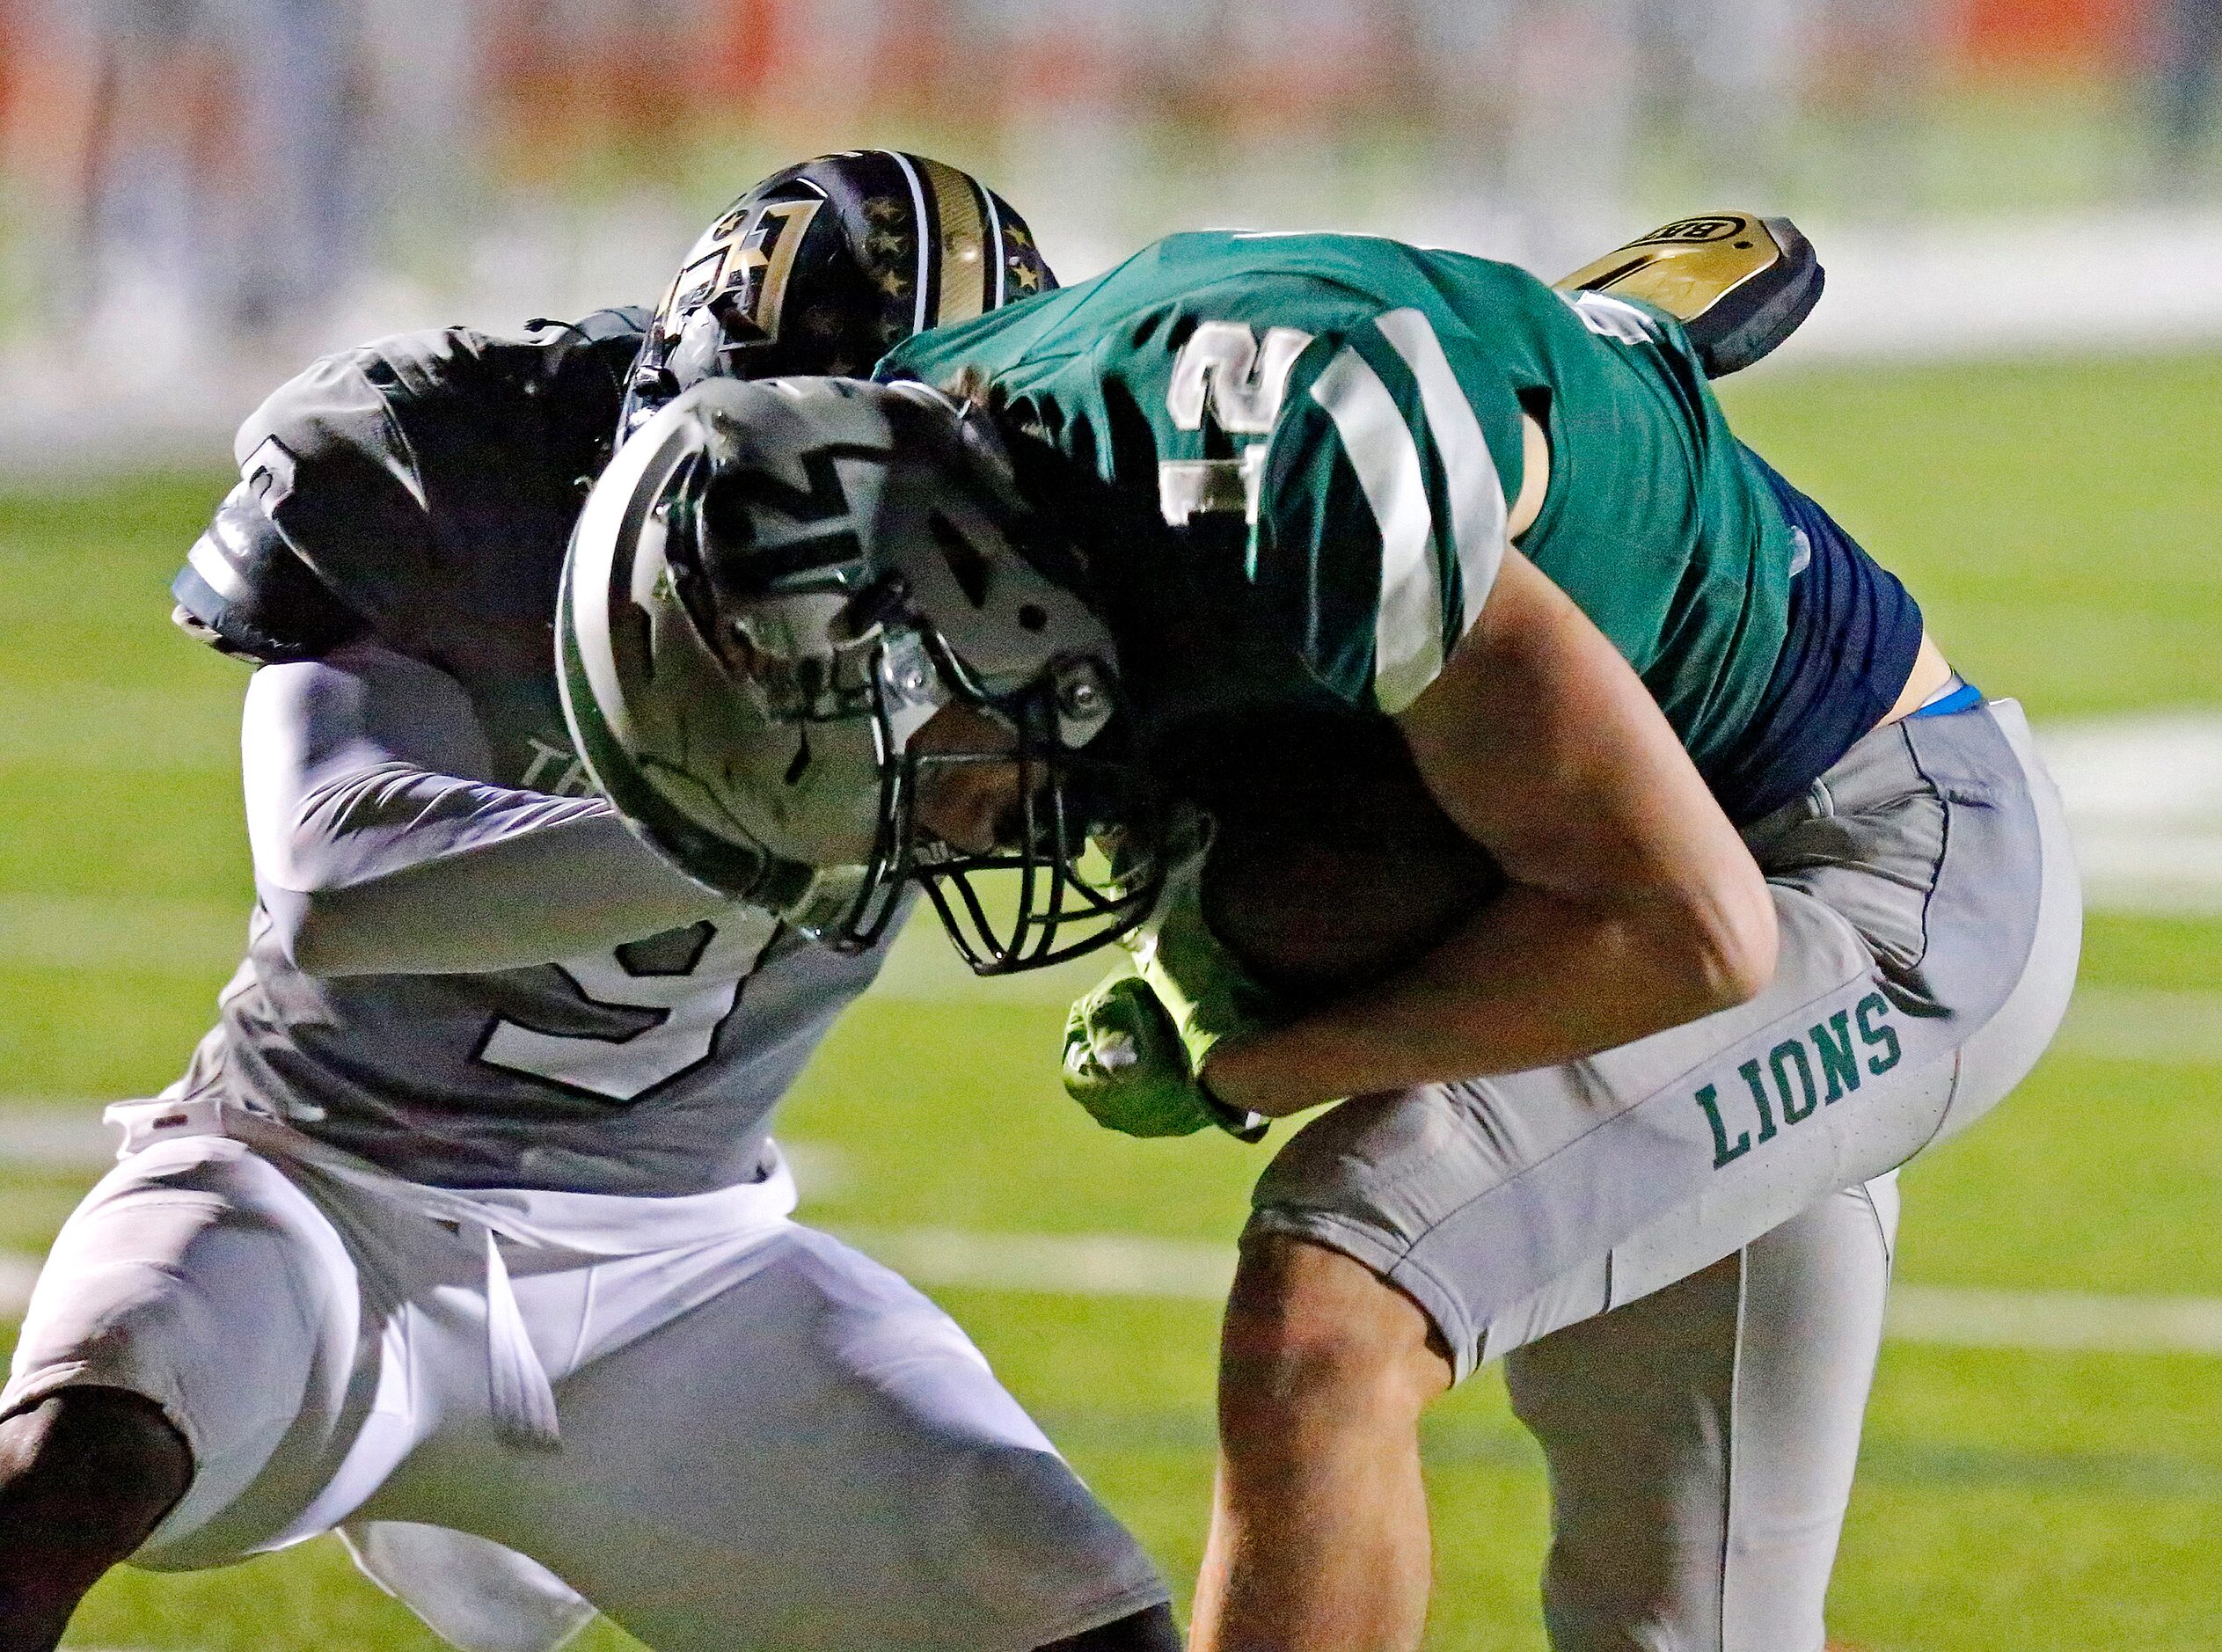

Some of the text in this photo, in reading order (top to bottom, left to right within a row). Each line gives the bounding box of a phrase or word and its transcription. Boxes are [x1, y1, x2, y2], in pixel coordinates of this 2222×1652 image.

[1159, 320, 1316, 528] 12
[476, 906, 782, 1102] 9
[1694, 991, 1902, 1172] LIONS
